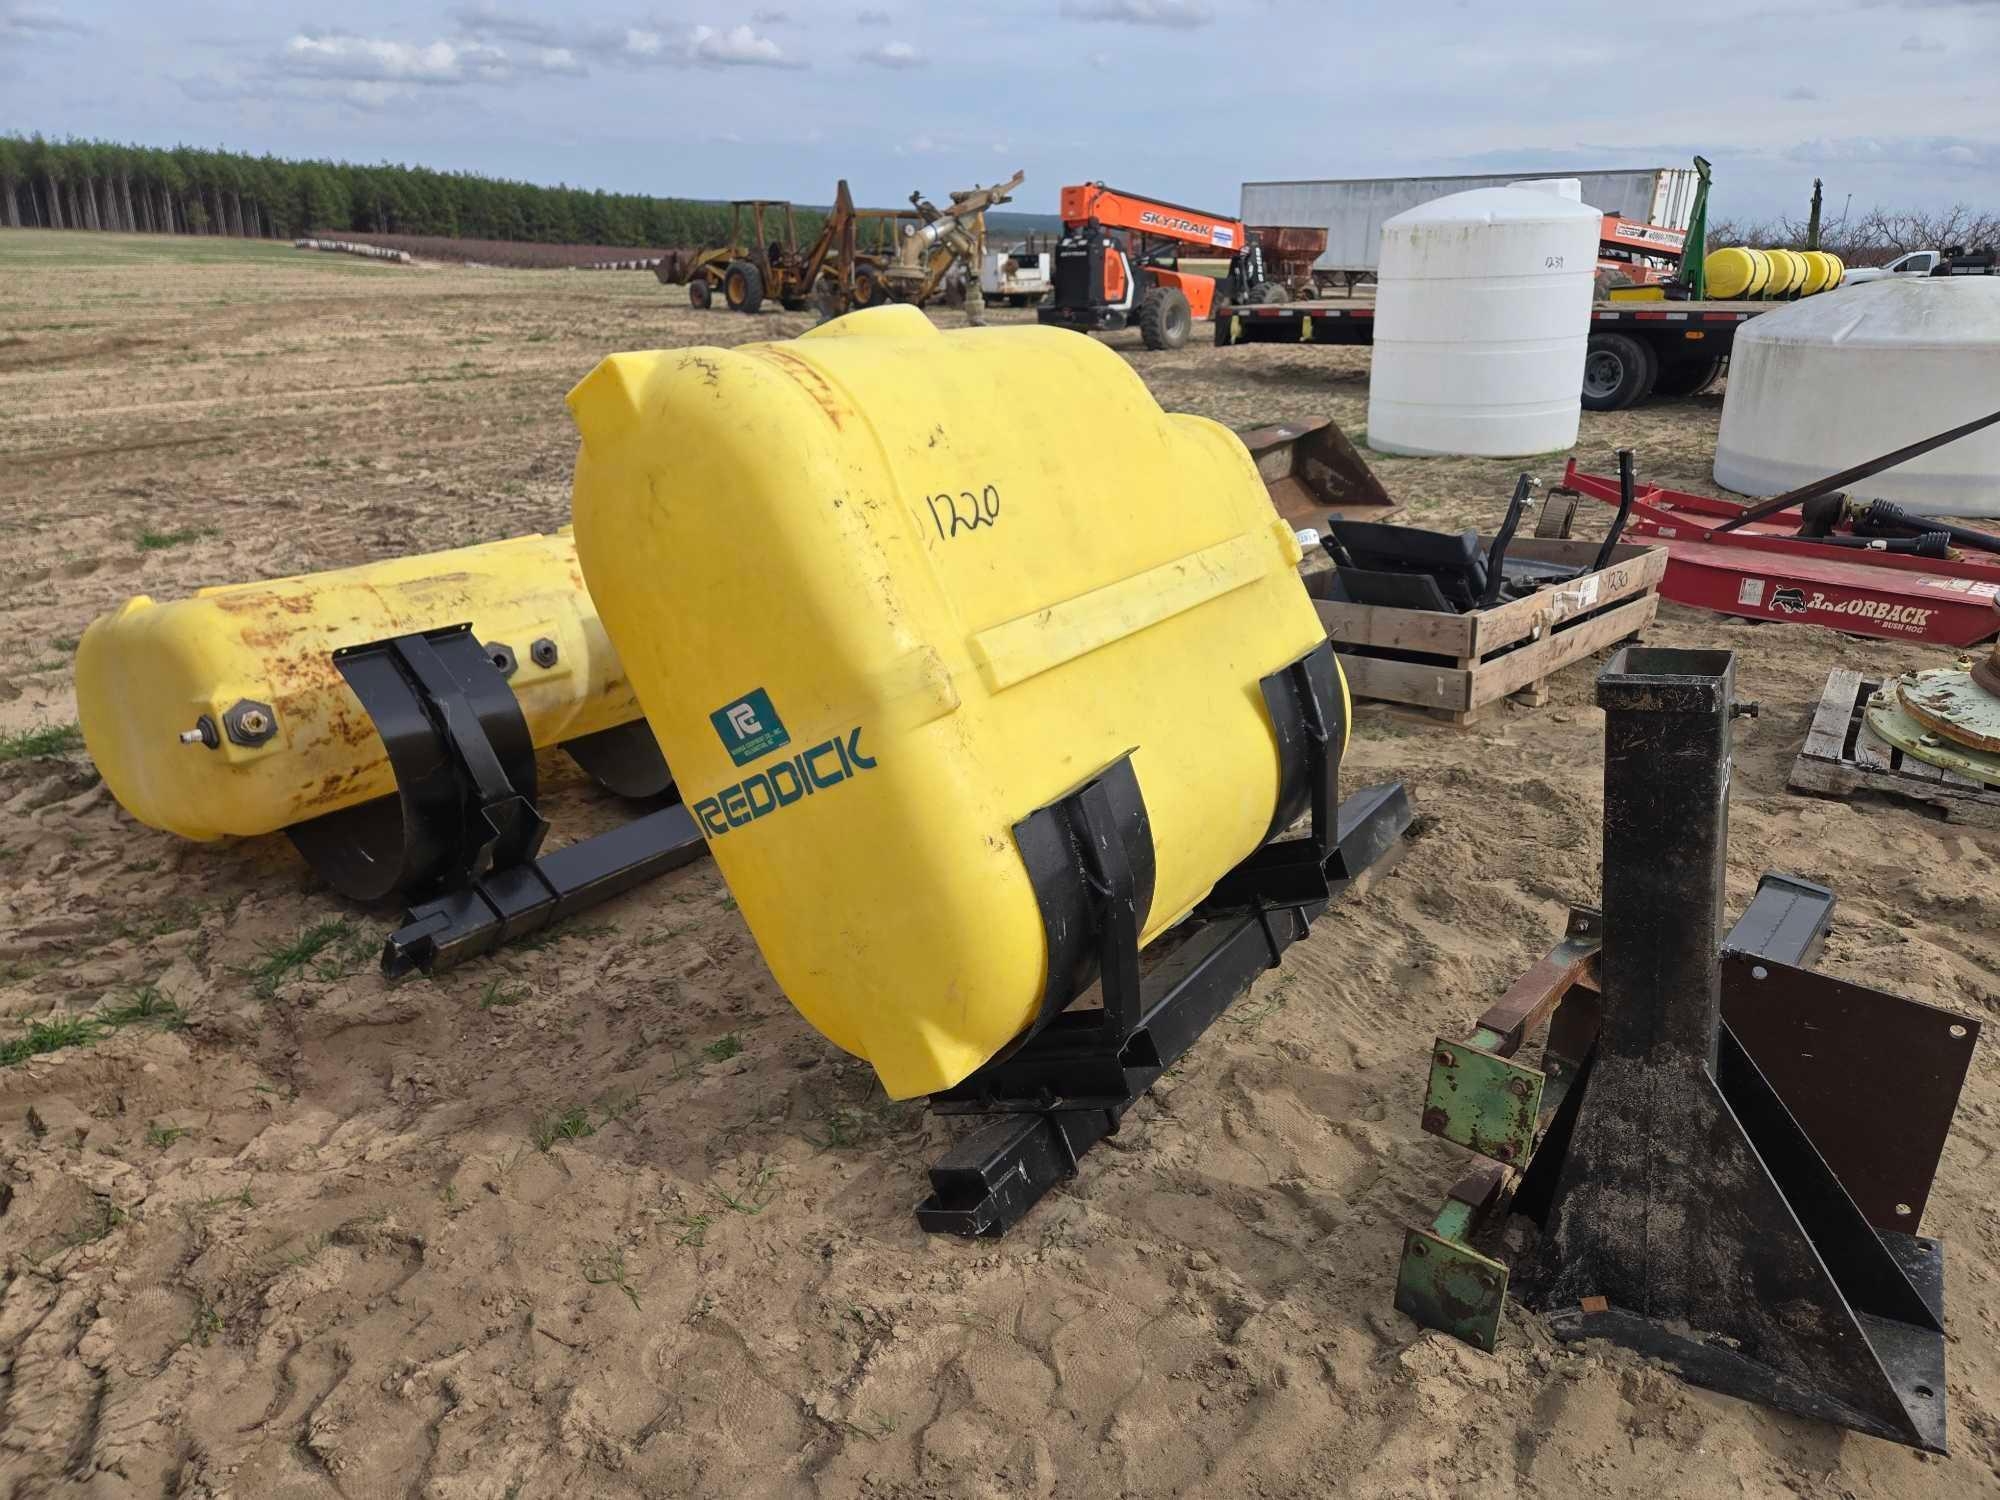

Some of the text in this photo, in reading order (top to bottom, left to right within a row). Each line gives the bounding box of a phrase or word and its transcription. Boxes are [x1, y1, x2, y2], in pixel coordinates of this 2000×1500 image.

[1140, 211, 1209, 236] SKYTRAK
[926, 484, 1000, 541] 1220
[1882, 621, 1904, 631] BUSH
[1905, 624, 1924, 634] HOG
[692, 726, 878, 840] REDDICK
